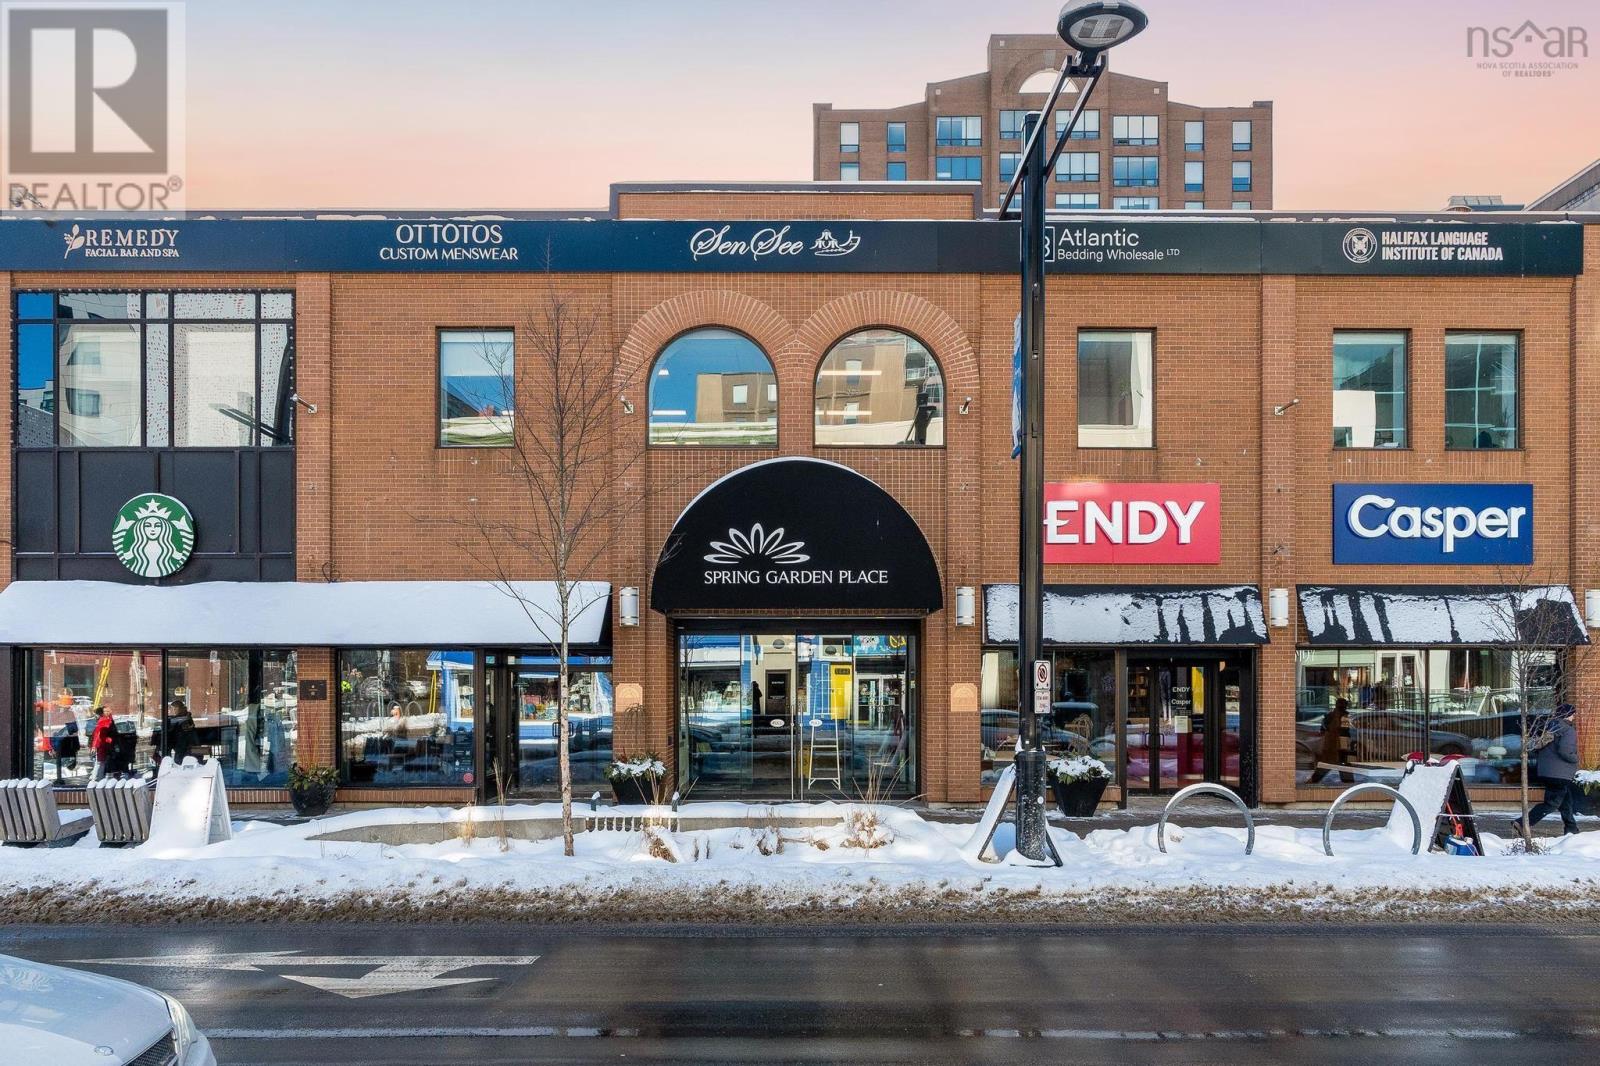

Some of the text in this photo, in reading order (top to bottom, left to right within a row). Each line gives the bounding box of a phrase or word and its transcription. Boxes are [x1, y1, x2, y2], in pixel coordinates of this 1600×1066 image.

[85, 228, 179, 246] REMEDY
[1058, 228, 1139, 246] Atlantic
[1381, 231, 1428, 245] HALIFAX
[1431, 231, 1489, 245] LANGUAGE
[85, 248, 179, 257] FACIAL BAR AND SPA
[380, 247, 518, 260] CUSTOM MENSWEAR
[1057, 248, 1180, 262] Bedding Wholesale LTD
[1381, 247, 1504, 261] INSTITUTE OF CANADA
[1043, 501, 1206, 544] ENDY
[1348, 494, 1526, 553] Casper
[704, 570, 889, 584] SPRING GARDEN PLACE
